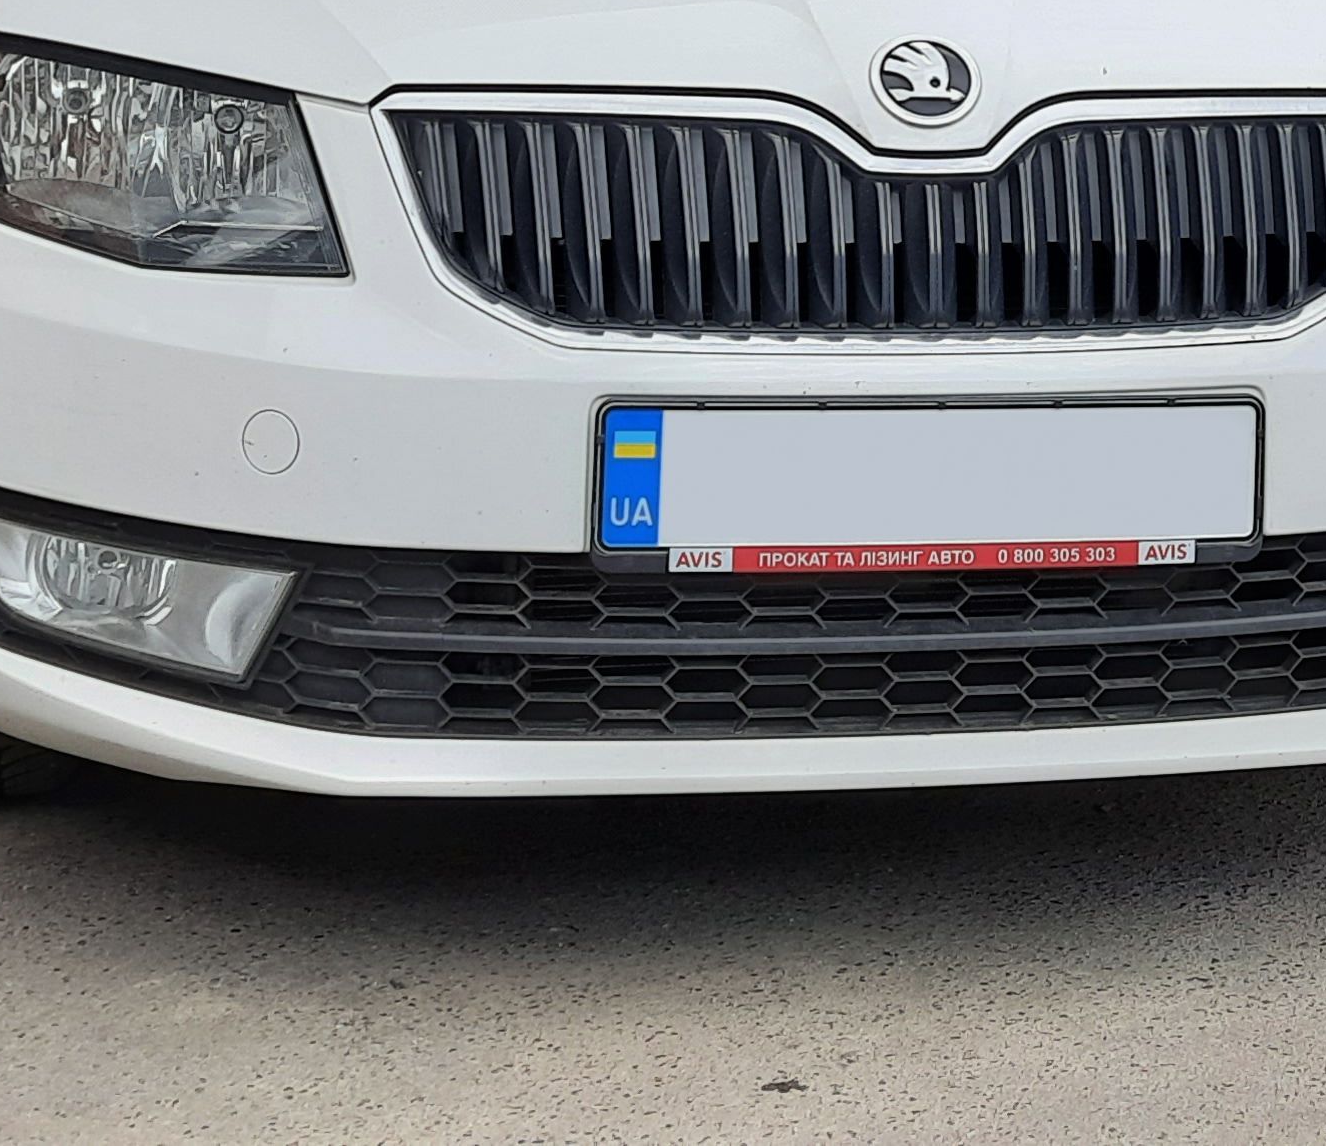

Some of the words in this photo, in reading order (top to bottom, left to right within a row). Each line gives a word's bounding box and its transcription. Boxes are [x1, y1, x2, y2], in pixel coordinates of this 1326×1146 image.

[609, 497, 654, 527] UA
[676, 552, 722, 569] AVIS
[759, 551, 831, 567] ПРОКАТ
[834, 551, 857, 567] ТА
[859, 550, 923, 567] ЛІЗИНГ
[928, 549, 974, 565] АВТО
[998, 548, 1008, 563] 0
[1013, 548, 1044, 563] 800
[1049, 548, 1080, 563] 305
[1084, 547, 1116, 562] 303
[1144, 544, 1188, 561] AVIS
